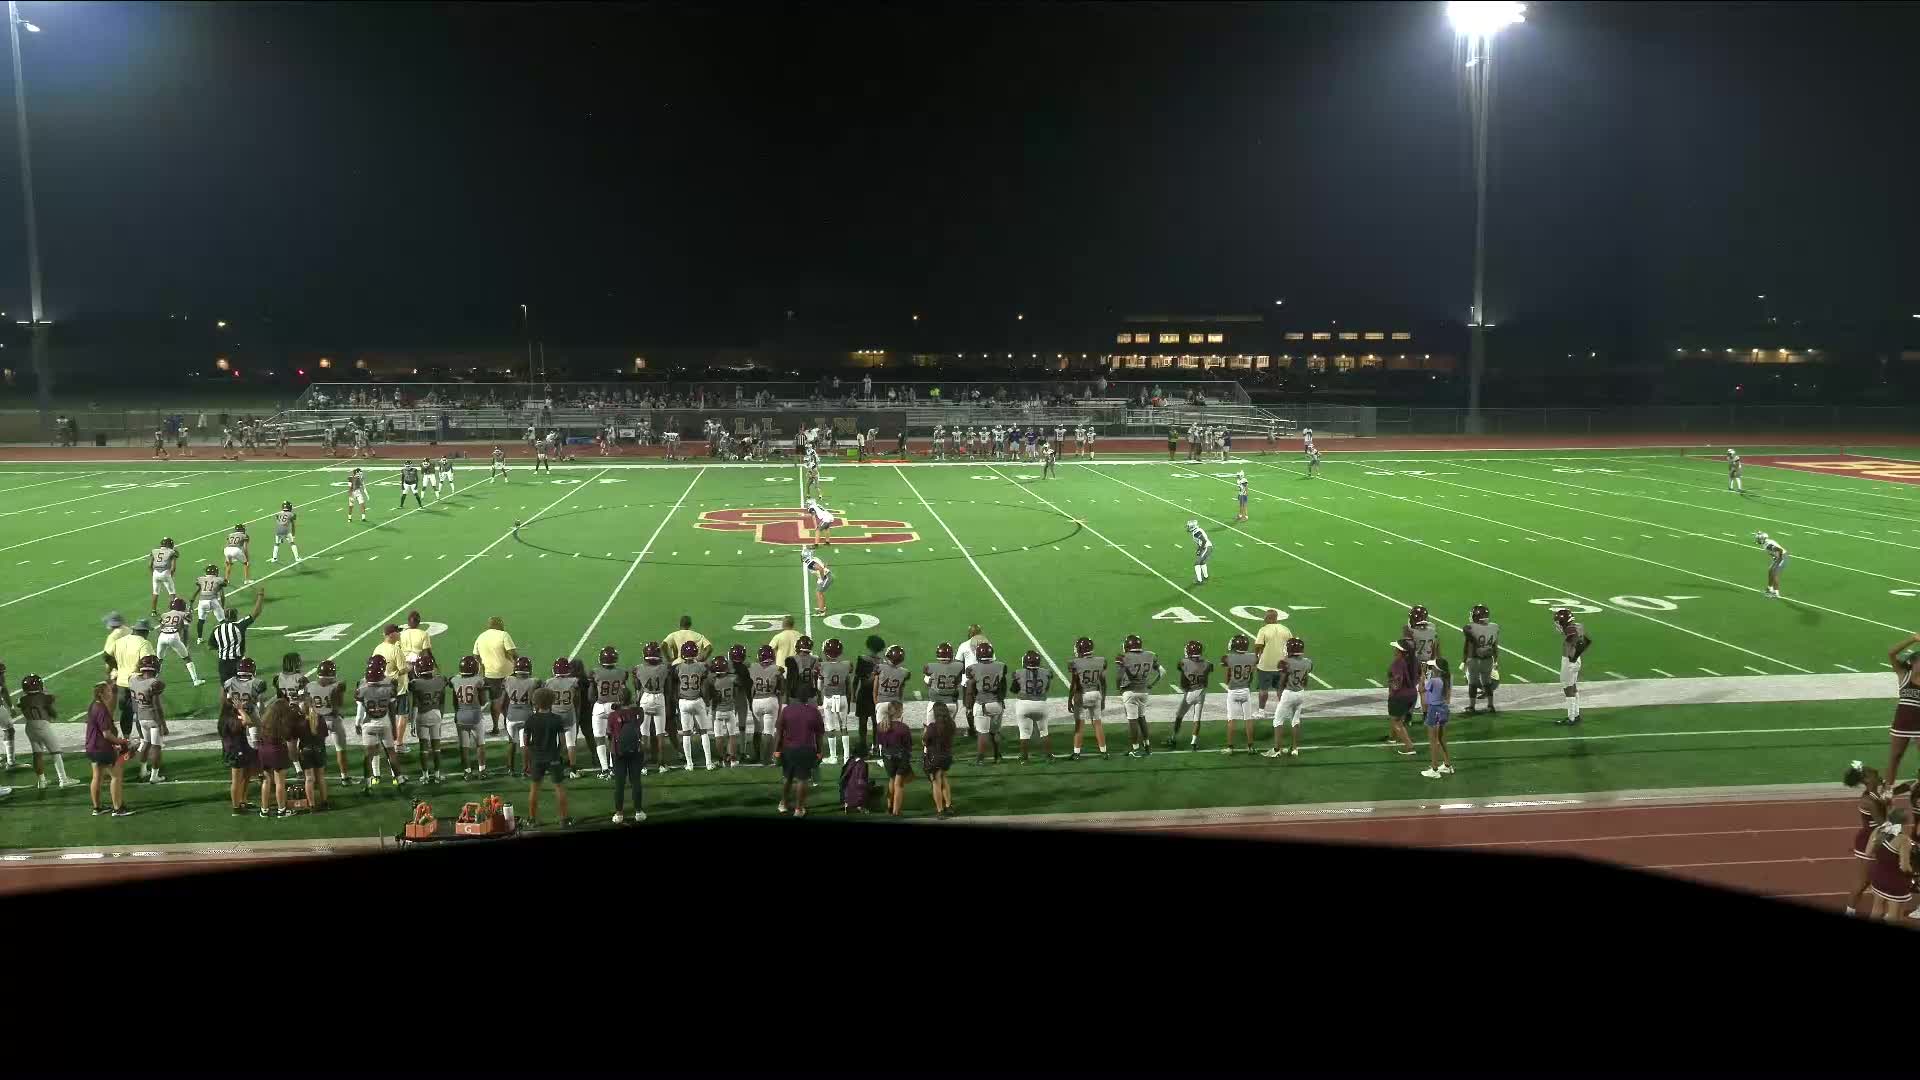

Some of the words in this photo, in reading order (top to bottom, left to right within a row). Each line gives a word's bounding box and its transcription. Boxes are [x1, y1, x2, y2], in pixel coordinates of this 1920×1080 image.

[732, 612, 881, 631] 50
[1151, 606, 1290, 623] 40
[456, 684, 474, 705] 46
